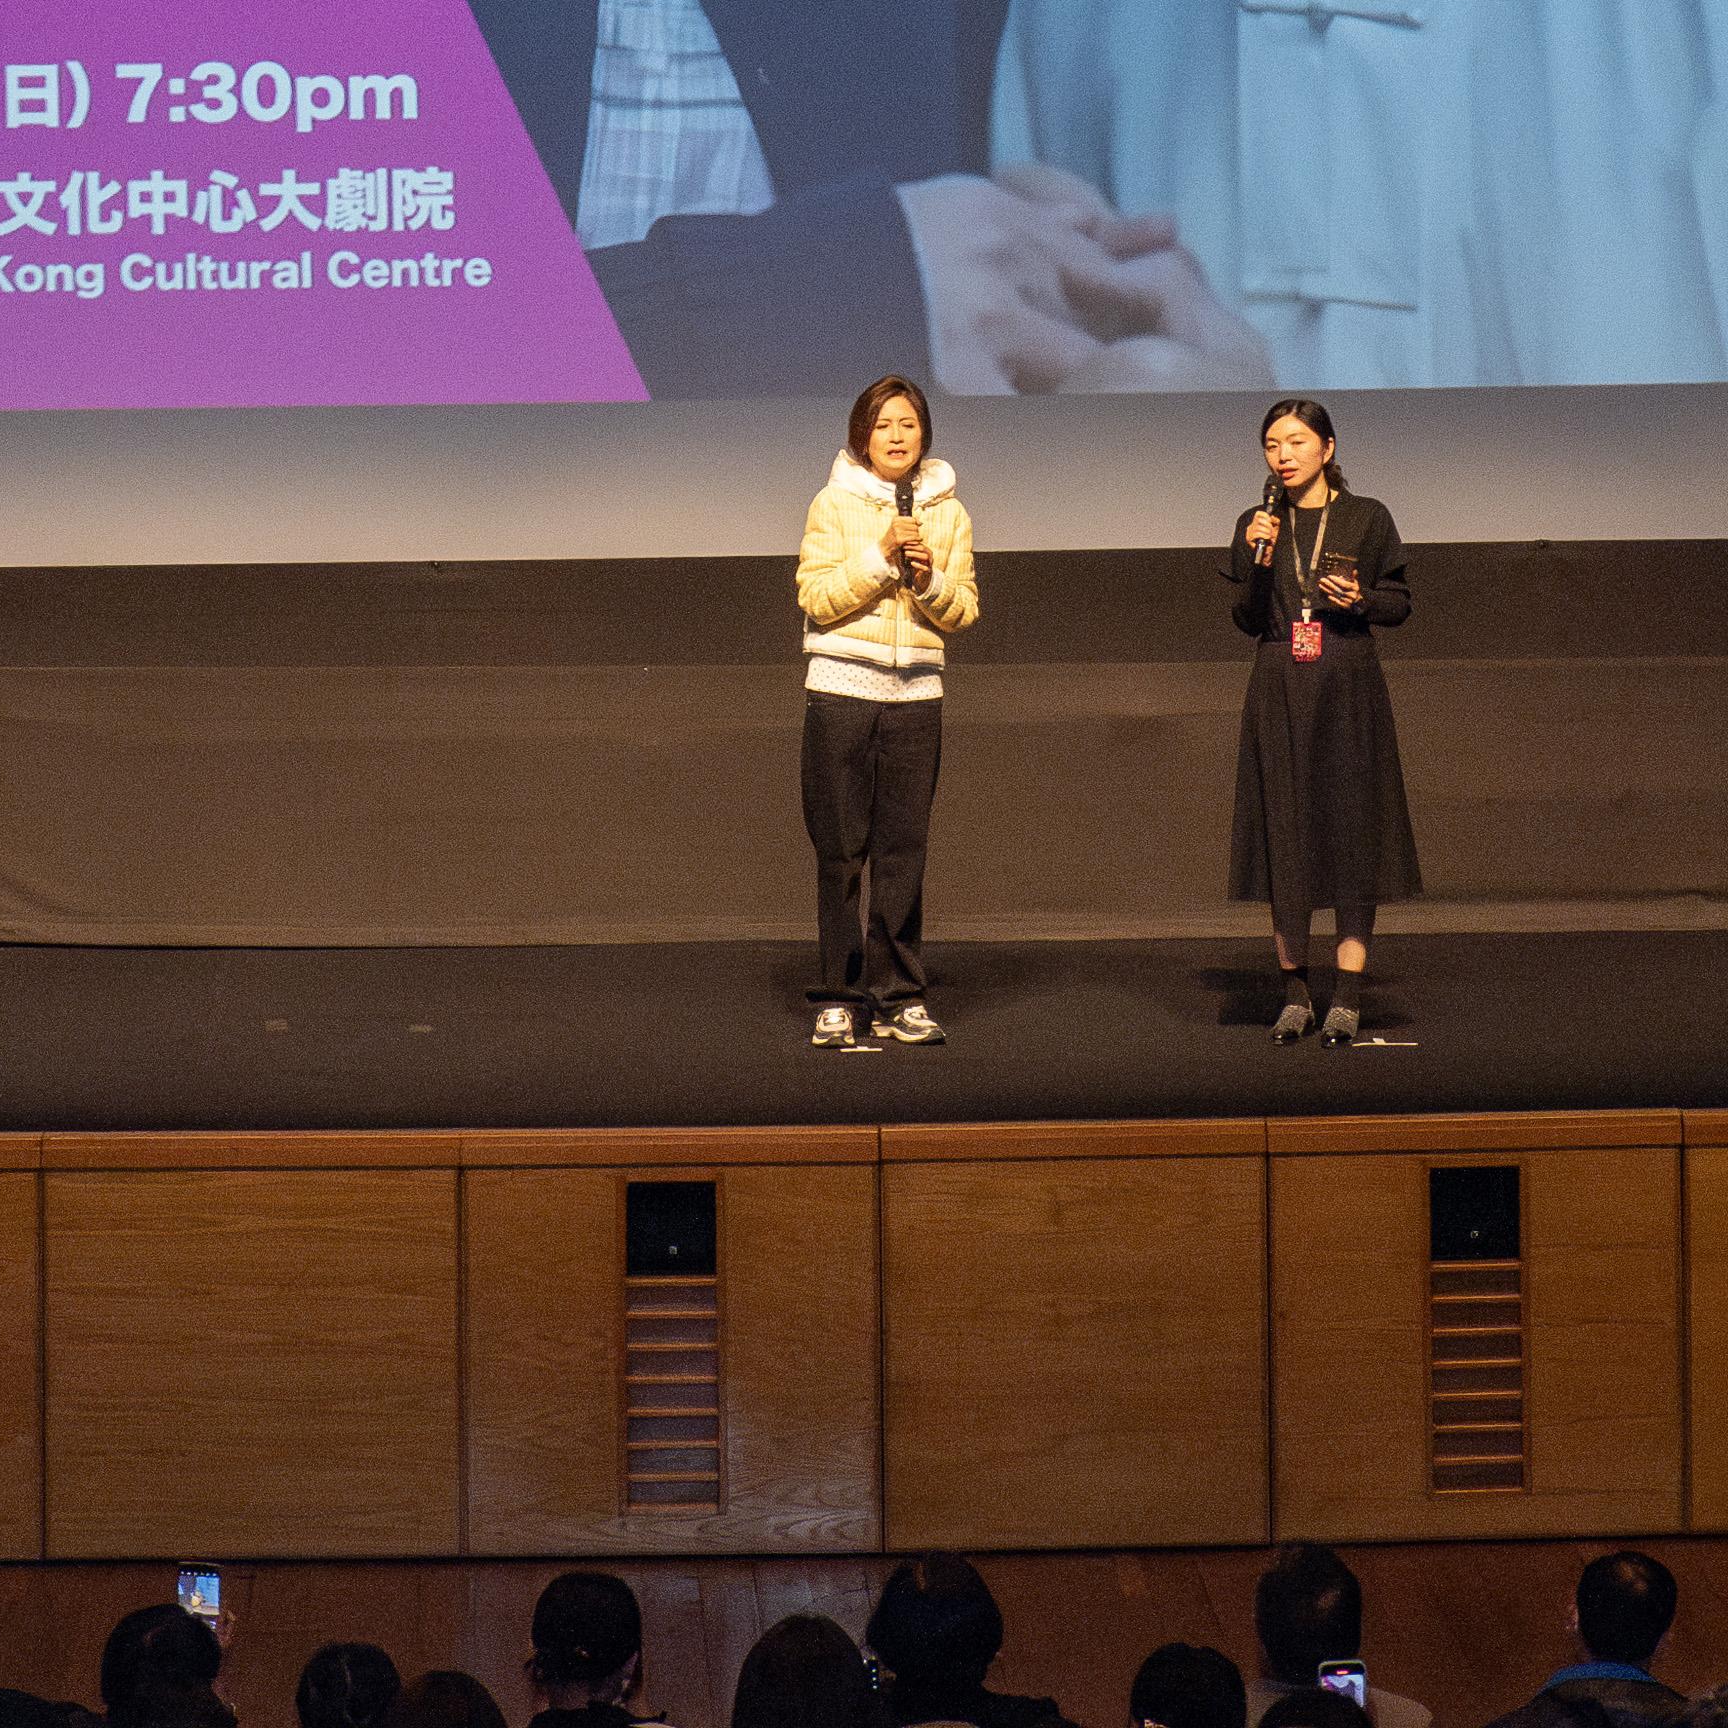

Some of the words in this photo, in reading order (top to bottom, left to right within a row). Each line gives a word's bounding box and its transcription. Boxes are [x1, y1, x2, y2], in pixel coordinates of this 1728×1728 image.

[5, 61, 91, 129] 日)
[116, 61, 419, 133] 7:30pm
[120, 251, 313, 291] Cultural
[327, 250, 493, 289] Centre
